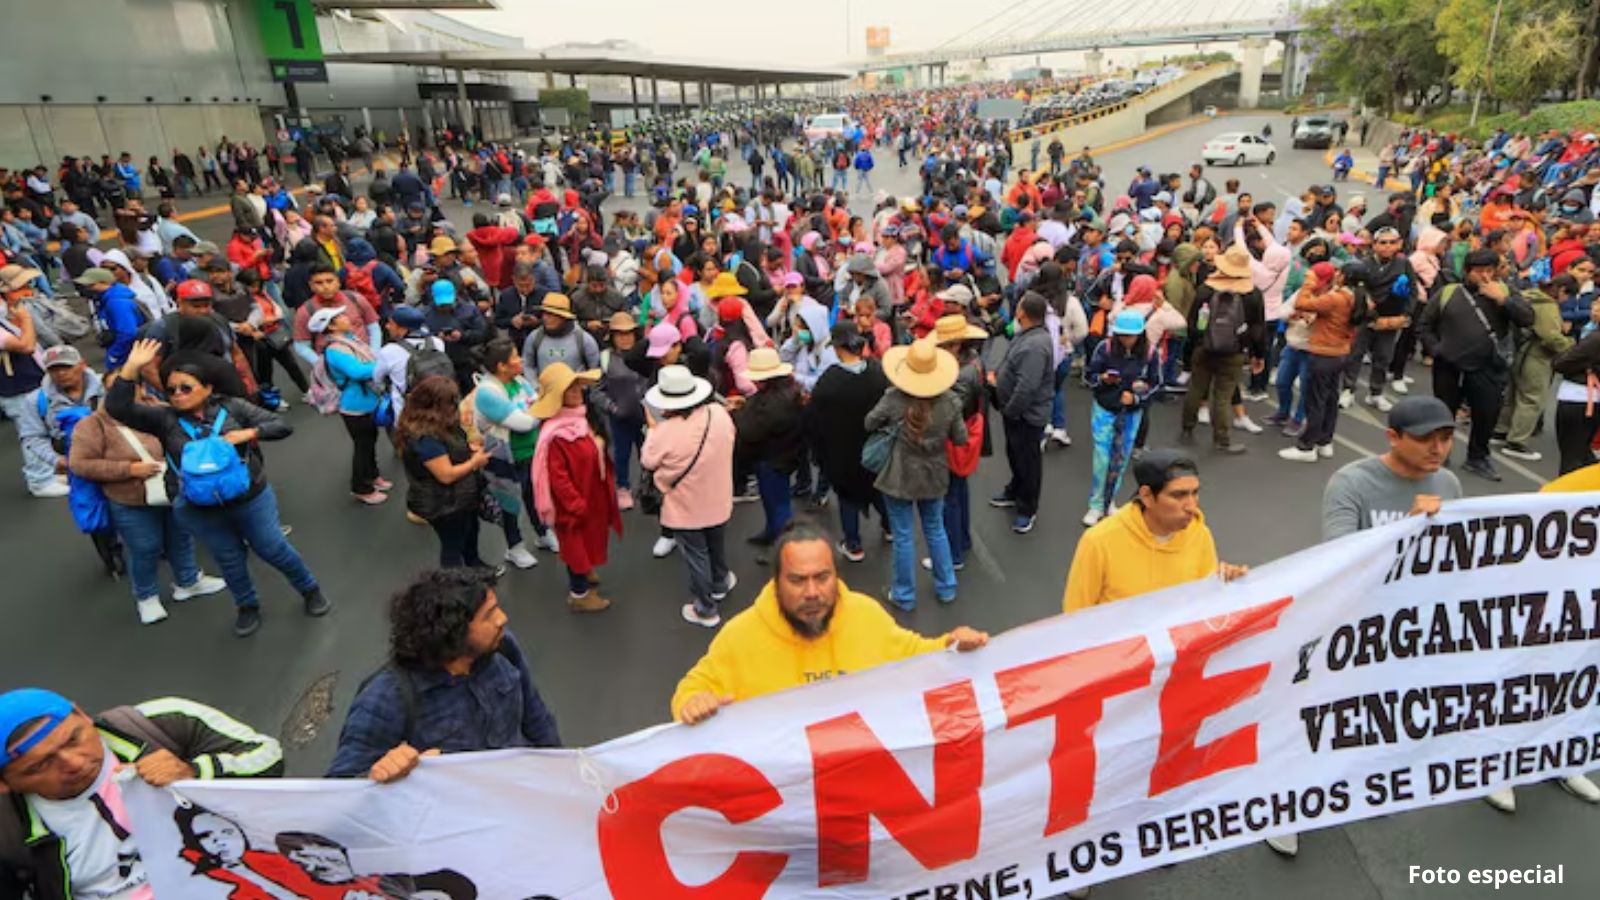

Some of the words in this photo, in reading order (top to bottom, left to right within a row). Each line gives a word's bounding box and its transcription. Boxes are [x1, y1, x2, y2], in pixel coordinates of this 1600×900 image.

[274, 0, 304, 49] 1
[597, 596, 1293, 900] CNTE
[1301, 664, 1600, 753] VENCEREMO
[1047, 831, 1123, 881] LOS
[1138, 780, 1350, 857] DERECHOS
[1365, 767, 1414, 805] SE
